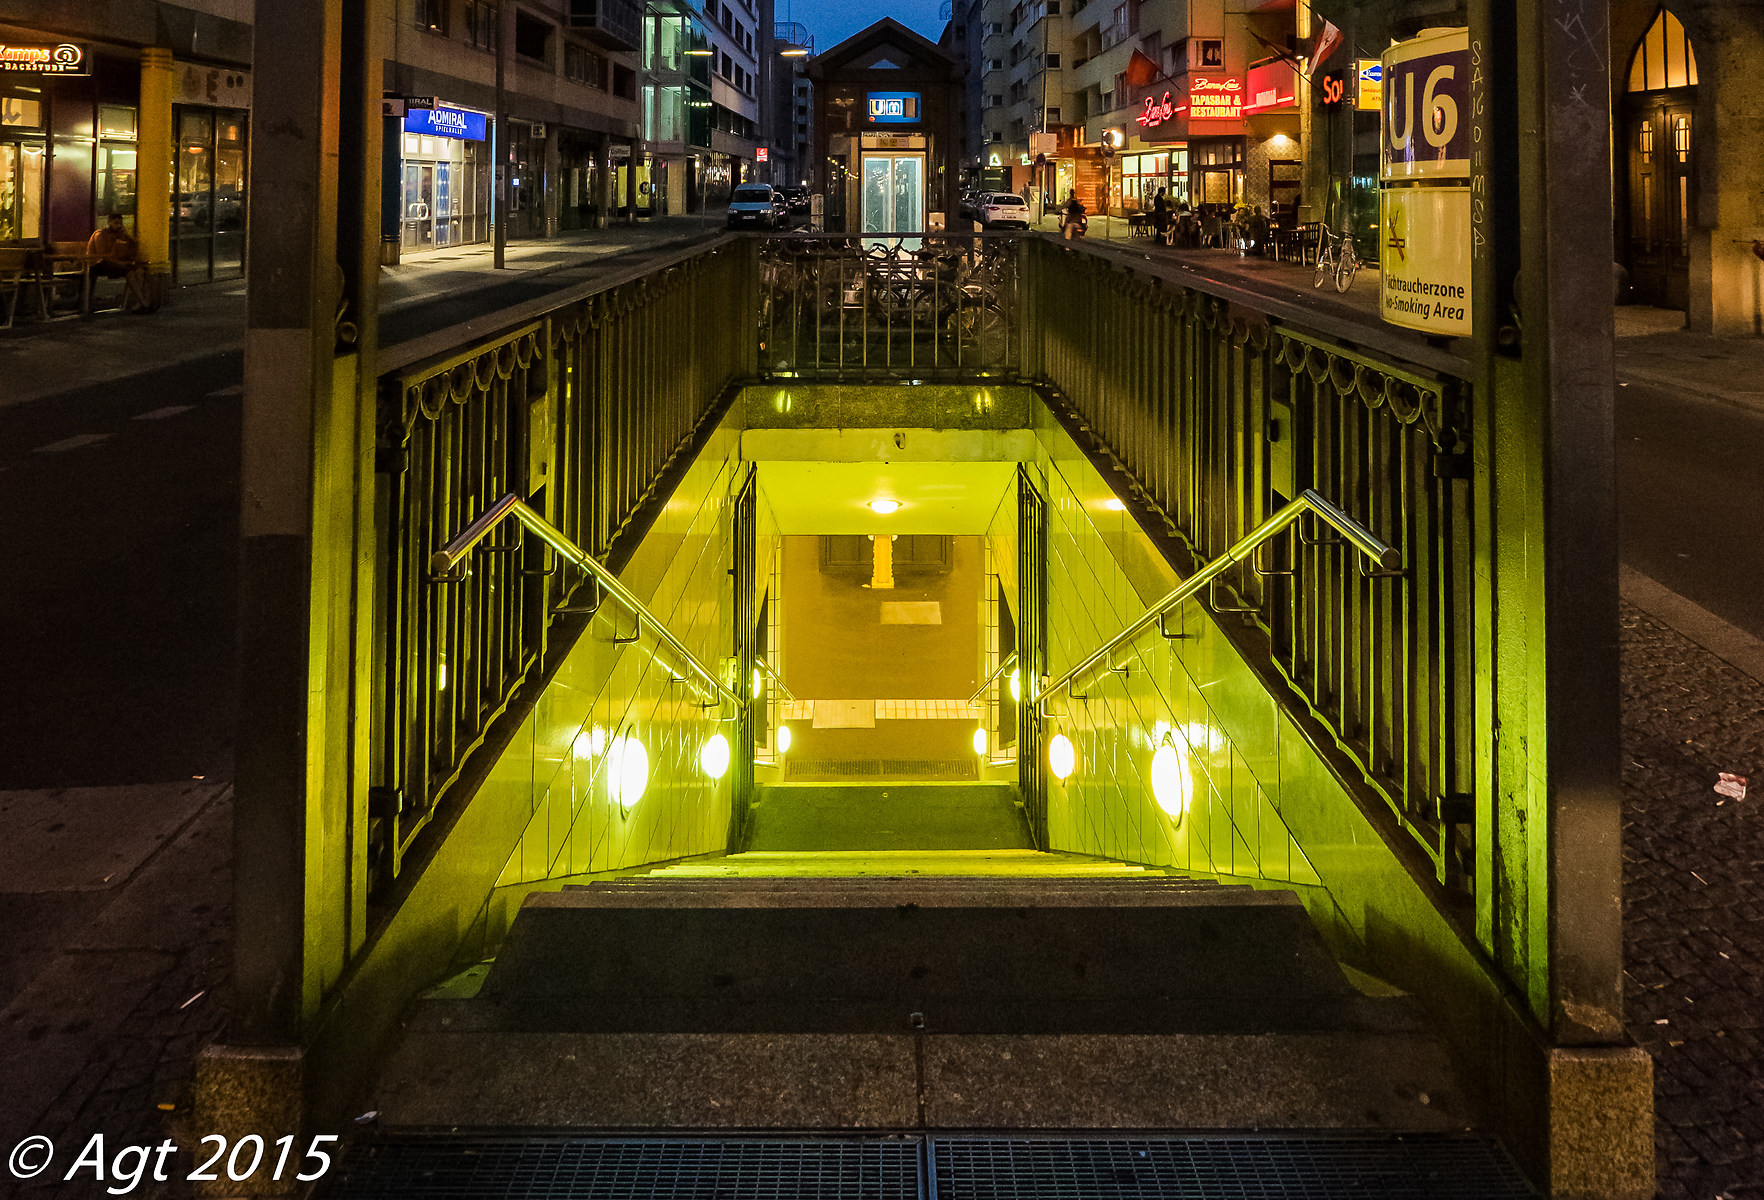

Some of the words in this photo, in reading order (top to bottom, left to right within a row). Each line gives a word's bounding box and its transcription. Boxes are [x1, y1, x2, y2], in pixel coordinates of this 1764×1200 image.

[1190, 94, 1232, 106] TAPASBAR
[1233, 94, 1242, 106] &
[1389, 64, 1458, 151] U6
[427, 110, 468, 130] ADMIRAL
[1190, 106, 1242, 118] RESTAURANT
[1433, 301, 1465, 321] Area
